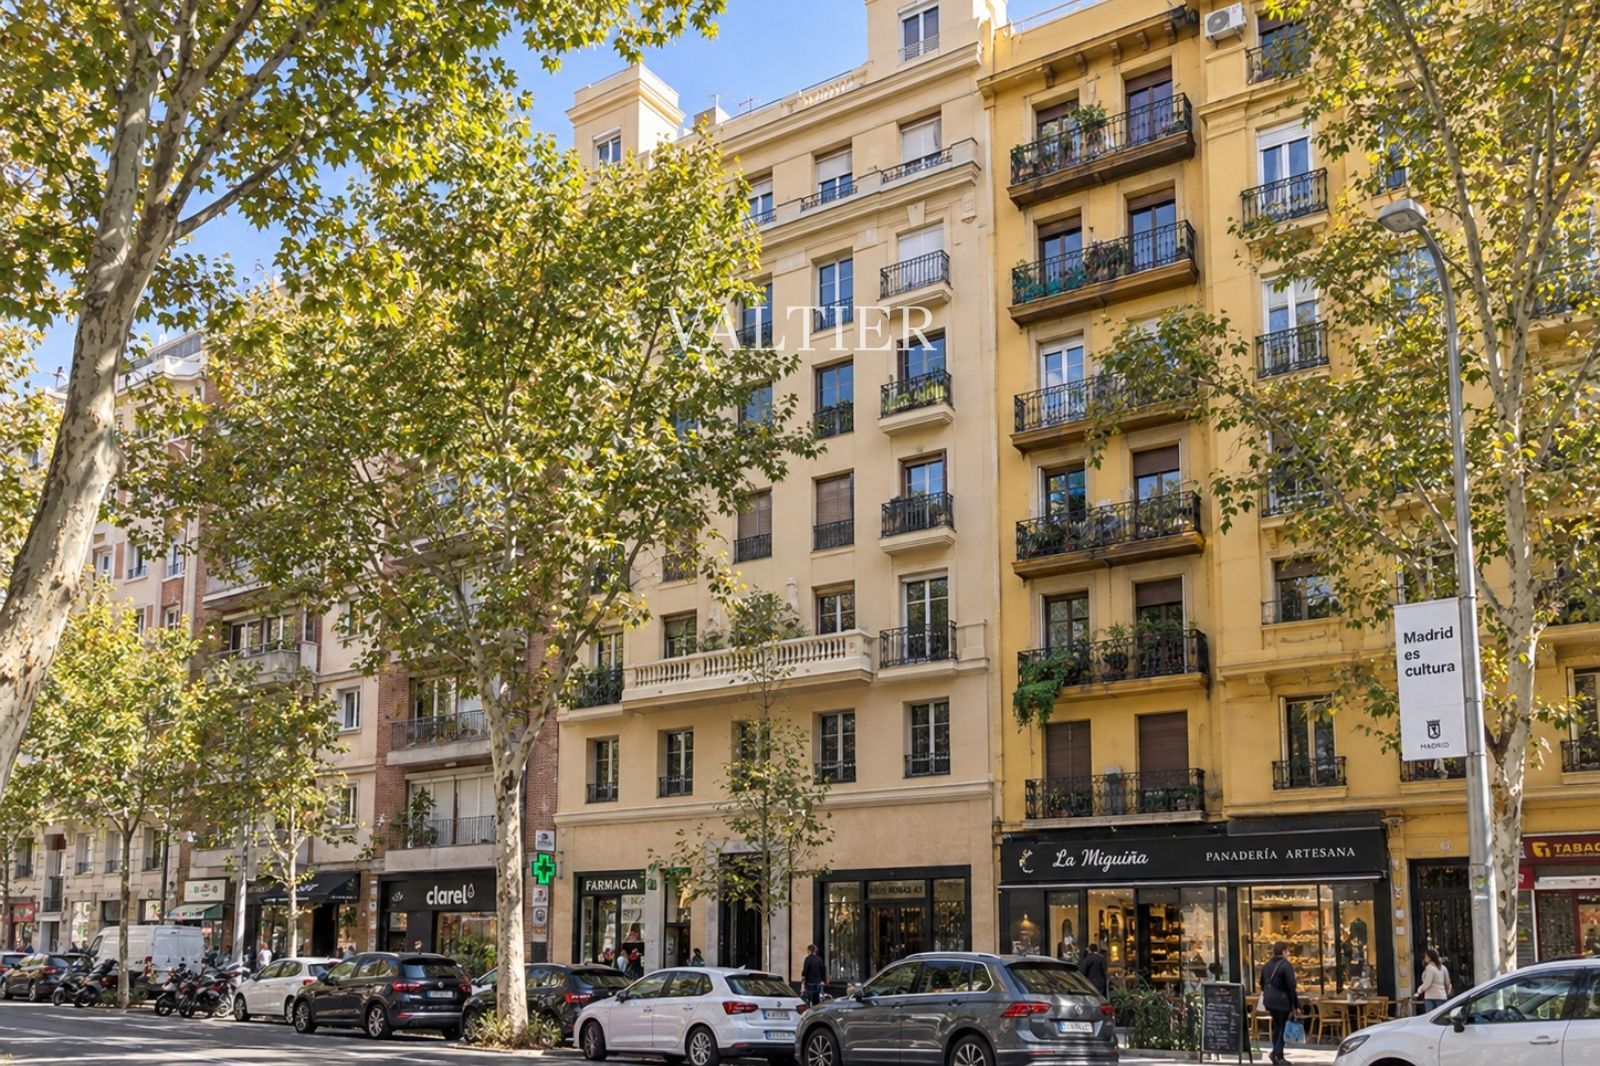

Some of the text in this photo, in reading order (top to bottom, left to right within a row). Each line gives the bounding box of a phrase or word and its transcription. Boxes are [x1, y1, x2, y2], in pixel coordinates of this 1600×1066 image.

[1403, 626, 1453, 644] Madrid
[1404, 649, 1420, 661] es
[1405, 662, 1455, 677] cultura
[1052, 848, 1149, 872] La Miguiña
[1206, 847, 1355, 861] PANADERÍA ARTESANA
[586, 878, 638, 891] FARMACIA
[426, 884, 468, 905] clarel
